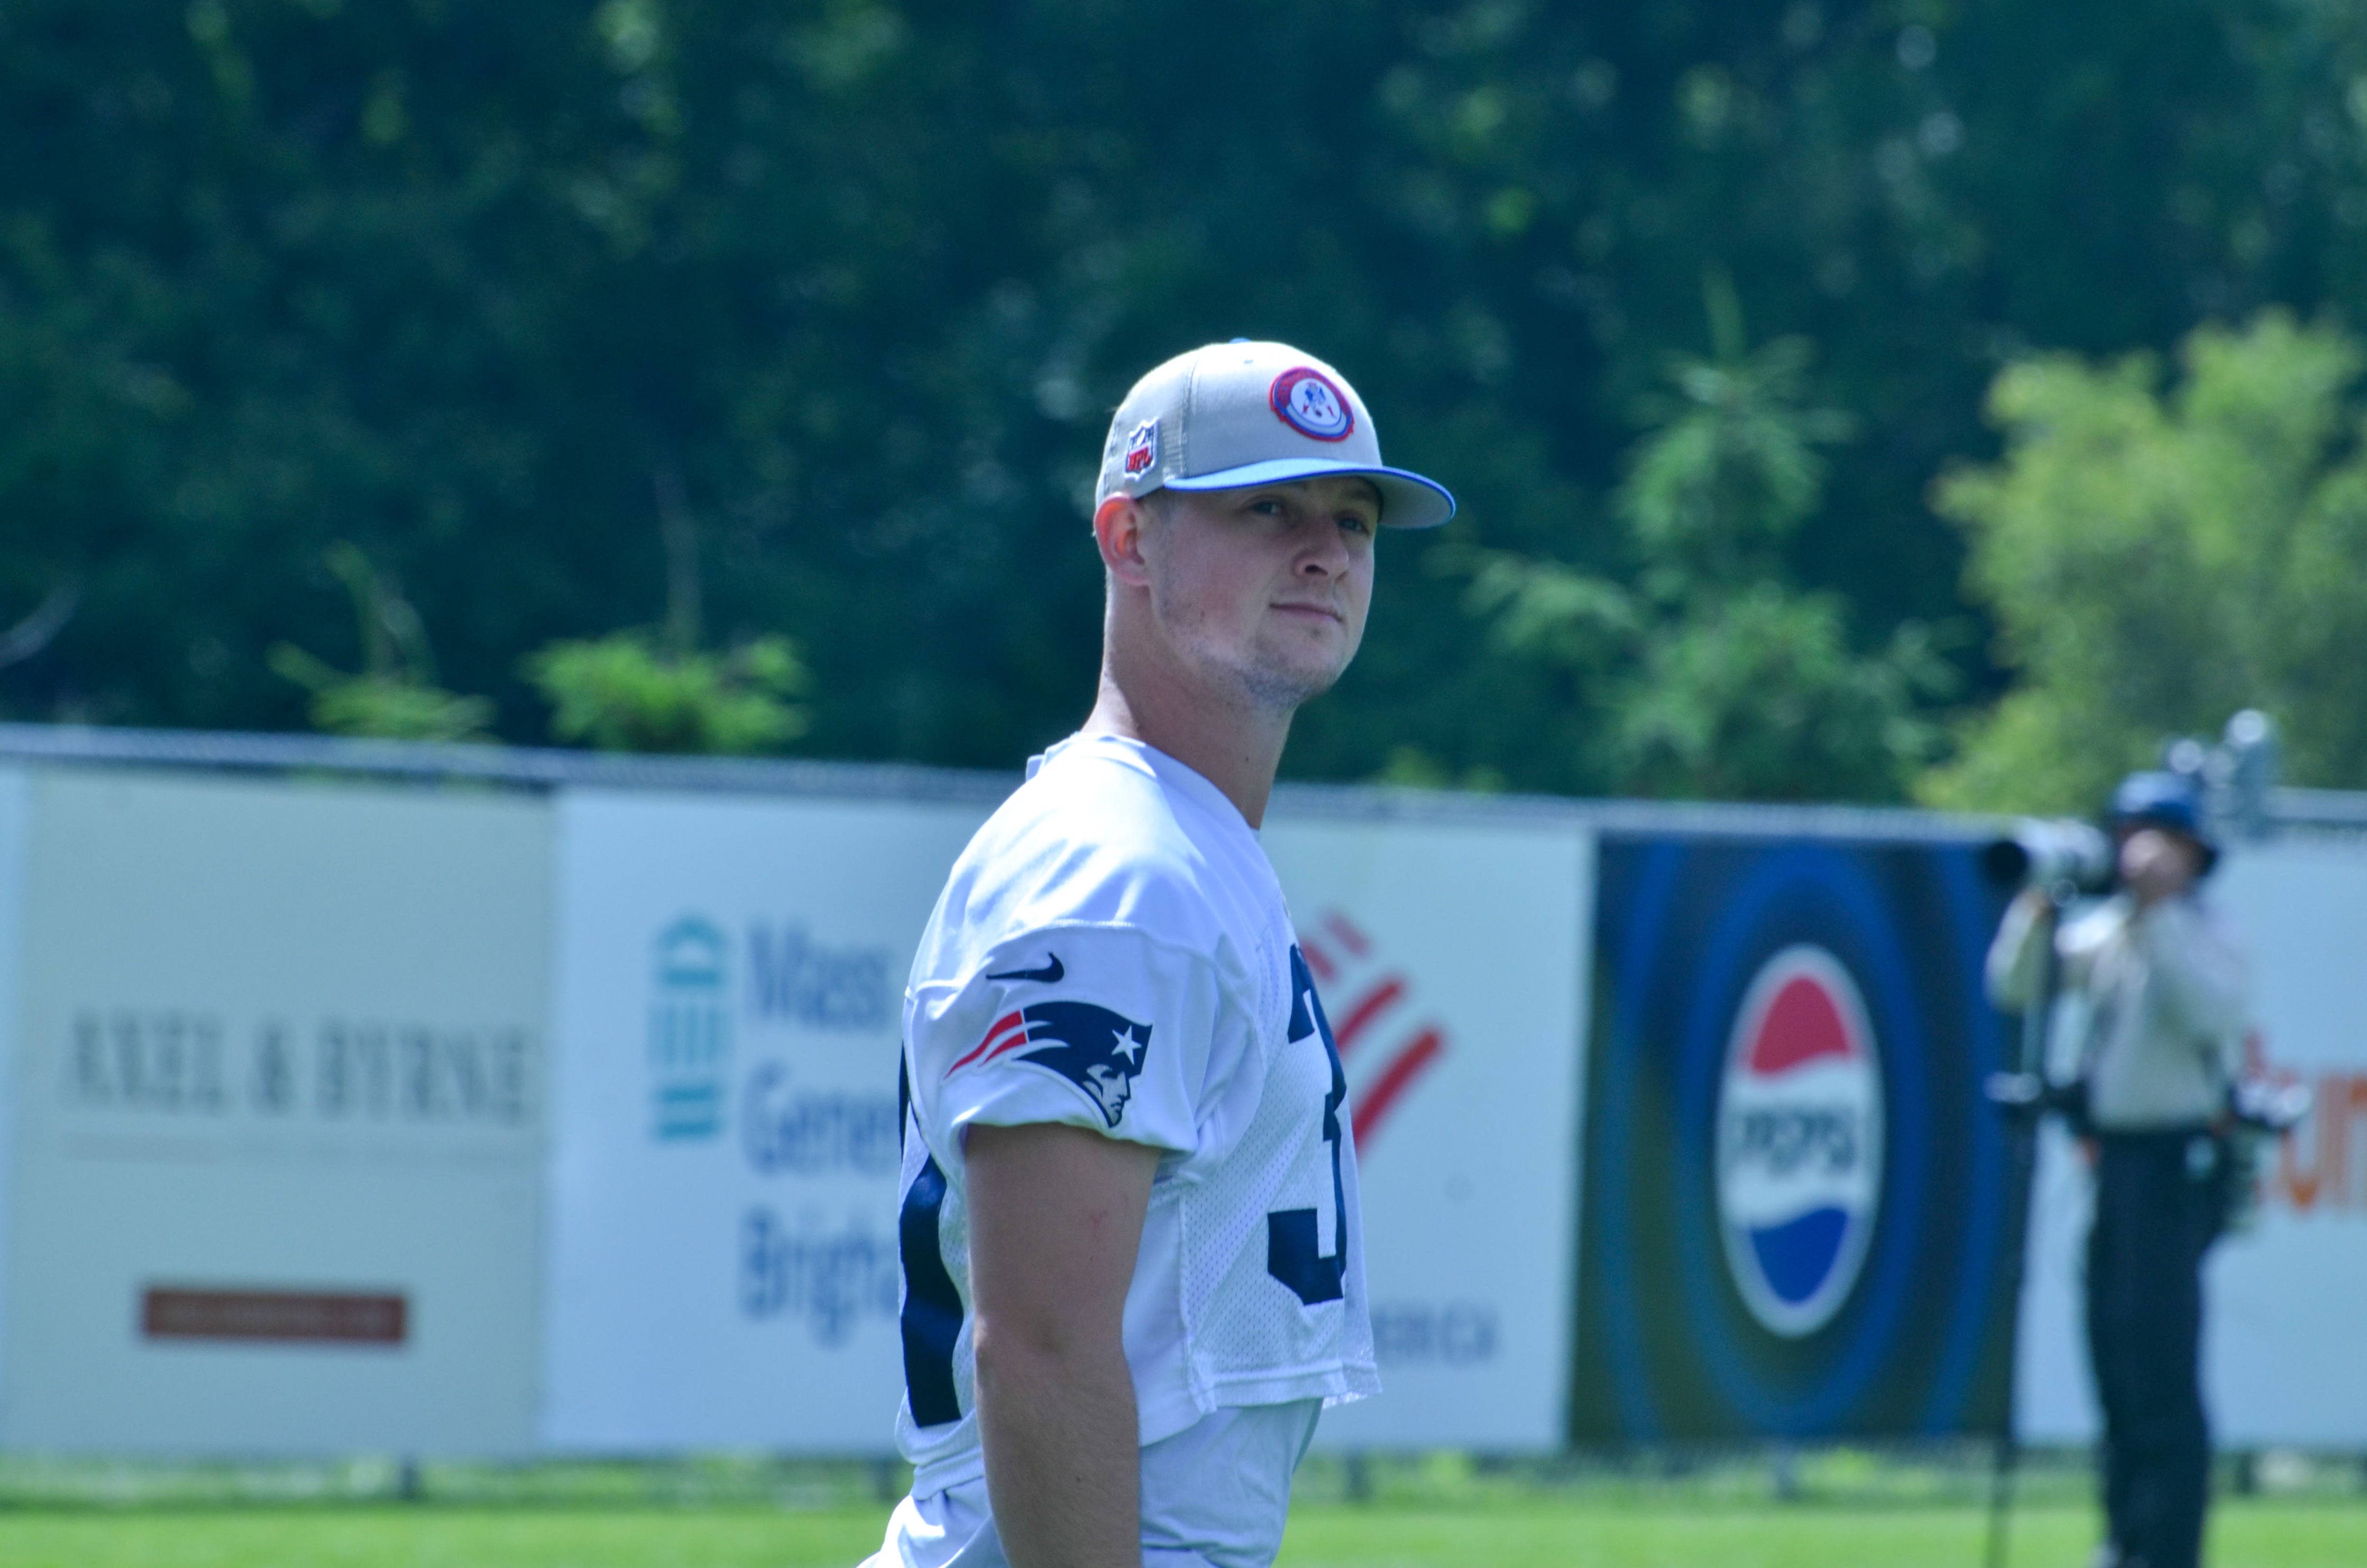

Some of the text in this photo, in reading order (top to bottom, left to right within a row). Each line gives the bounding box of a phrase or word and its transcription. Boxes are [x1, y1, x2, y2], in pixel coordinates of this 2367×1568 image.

[747, 921, 893, 1030] Mass
[61, 1010, 538, 1124] AXEL & BYRNE
